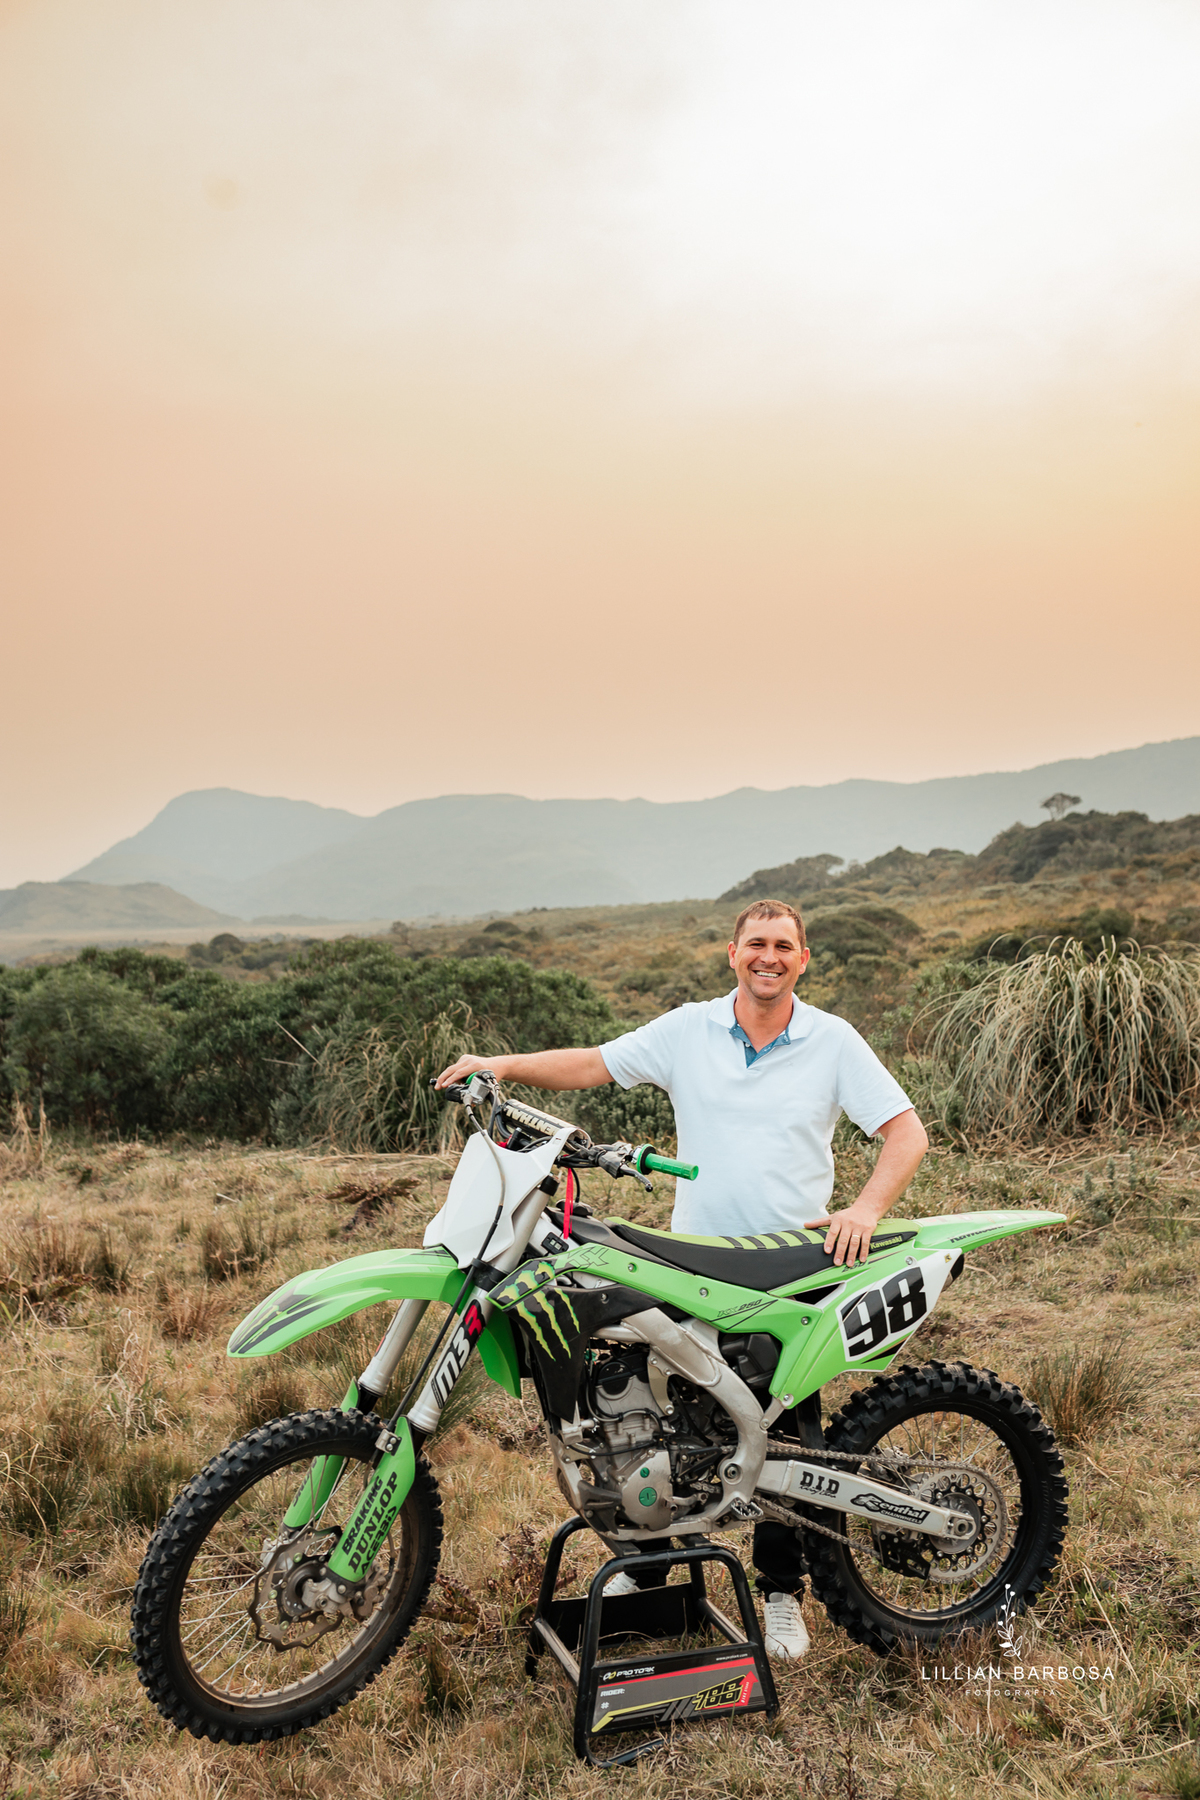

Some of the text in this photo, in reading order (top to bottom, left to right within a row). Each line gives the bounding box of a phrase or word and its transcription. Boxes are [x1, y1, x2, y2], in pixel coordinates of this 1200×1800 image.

[870, 1236, 903, 1249] Kawasaki
[840, 1267, 927, 1357] 98
[342, 1476, 384, 1556] BRAKING
[851, 1494, 927, 1519] Renthal
[348, 1471, 398, 1574] DUNLOP
[616, 1669, 634, 1678] PRO
[634, 1666, 656, 1675] TORK
[600, 1688, 626, 1697] RIDER:
